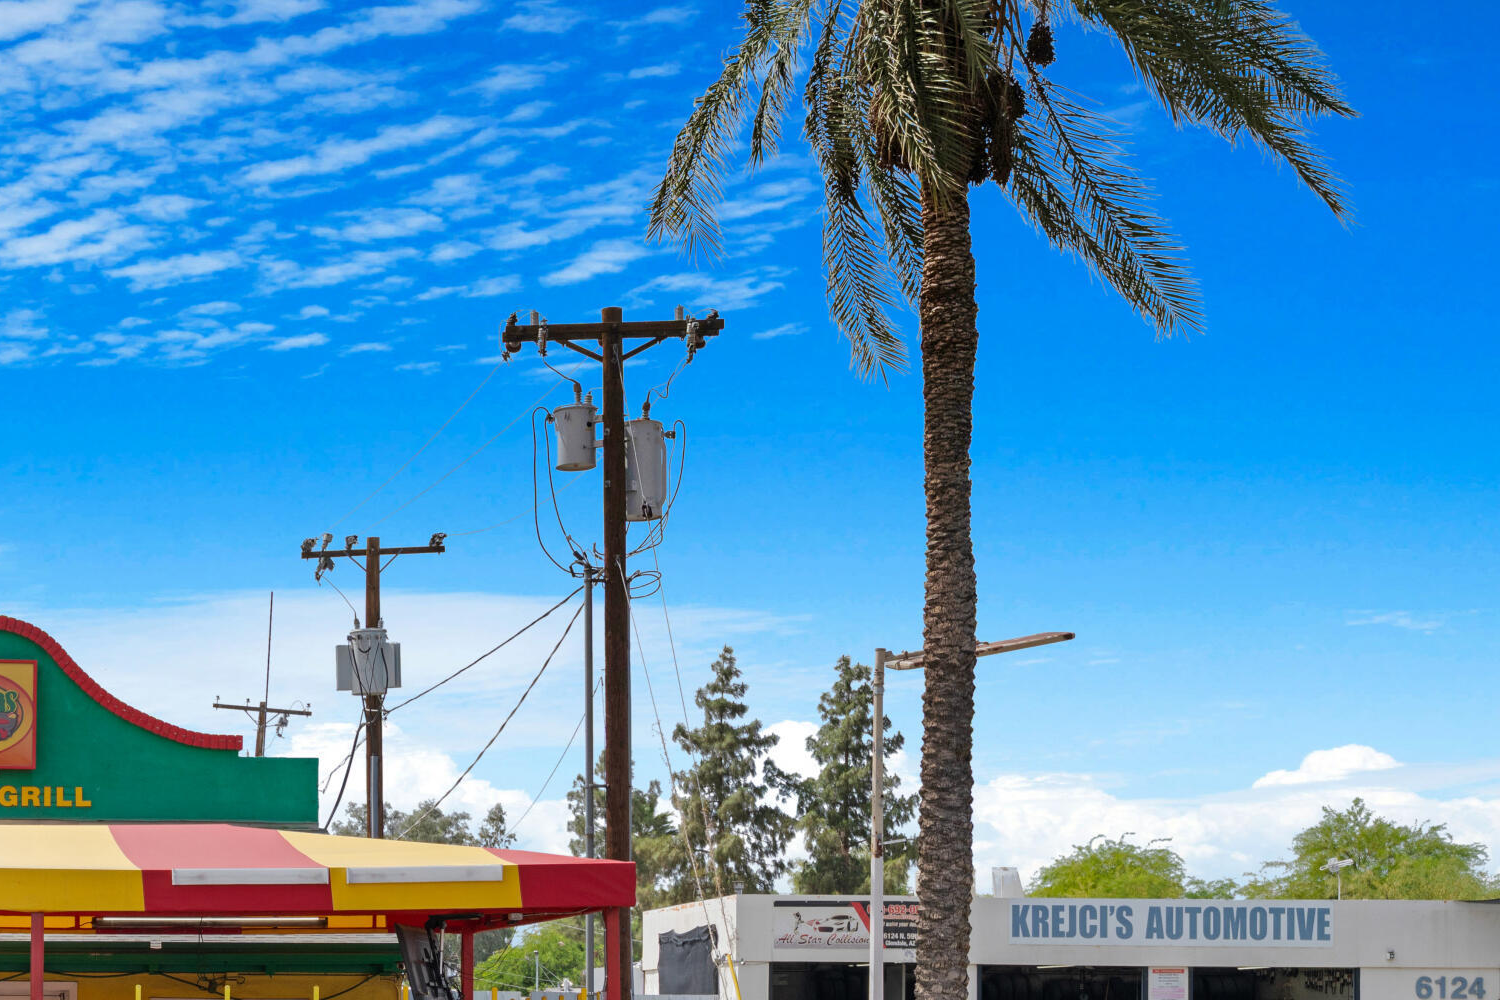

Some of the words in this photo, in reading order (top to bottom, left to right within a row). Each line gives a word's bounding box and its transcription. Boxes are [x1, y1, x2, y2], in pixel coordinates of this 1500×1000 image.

[1011, 904, 1134, 939] KREJCI'S
[1145, 906, 1331, 941] AUTOMOTIVE
[776, 933, 794, 944] All
[798, 933, 822, 945] Star
[827, 932, 870, 946] Collision
[1415, 975, 1487, 1000] 6124
